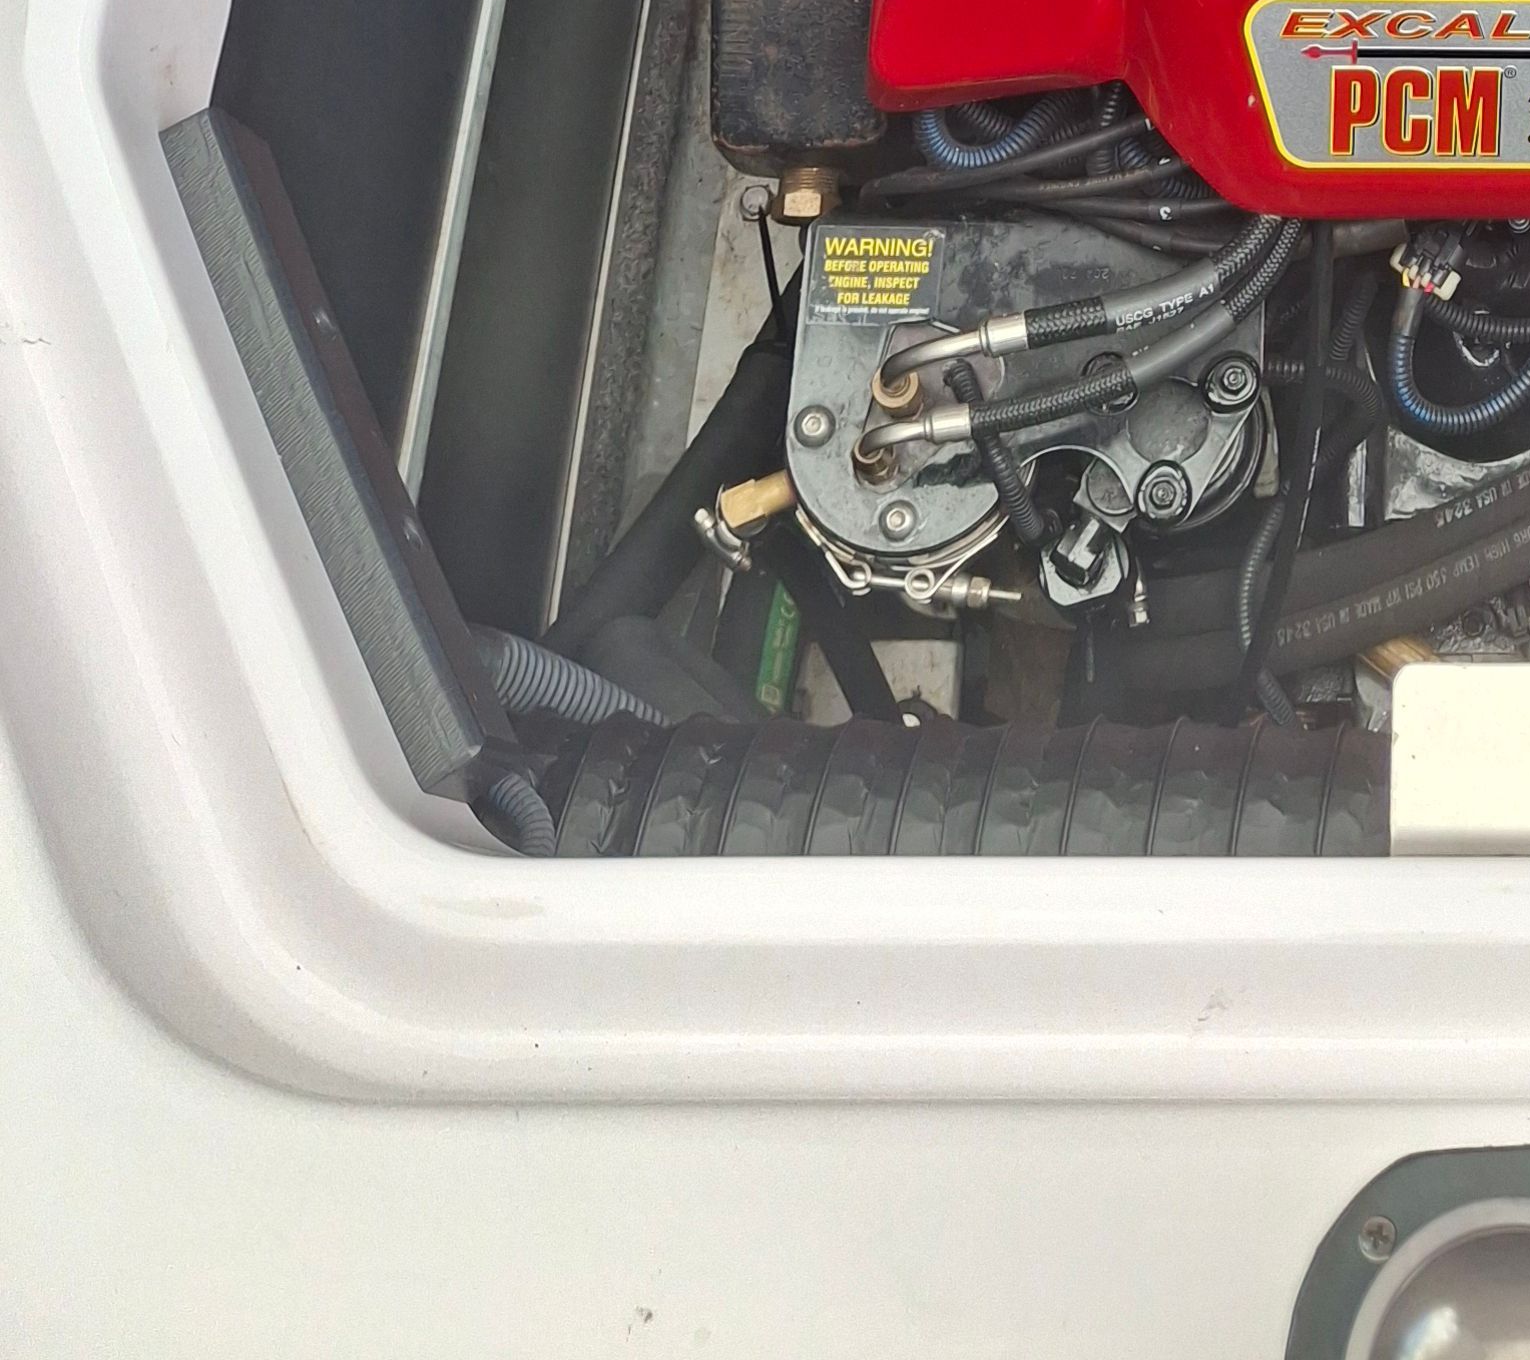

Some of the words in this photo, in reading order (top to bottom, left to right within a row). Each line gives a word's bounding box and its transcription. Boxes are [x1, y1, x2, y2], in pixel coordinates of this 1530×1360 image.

[1329, 65, 1503, 156] PCM
[824, 237, 934, 257] WARNING!
[824, 260, 867, 273] BEFORE
[868, 260, 930, 274] OPERATING
[828, 275, 871, 290] ENGINE,
[873, 276, 921, 290] INSPECT
[837, 292, 859, 305] FOR
[861, 293, 910, 306] LEAKAGE
[1116, 306, 1154, 326] USCG
[1159, 293, 1193, 312] TYPE
[1199, 284, 1213, 297] A1
[1475, 487, 1498, 509] USA
[1404, 578, 1423, 600] PSI
